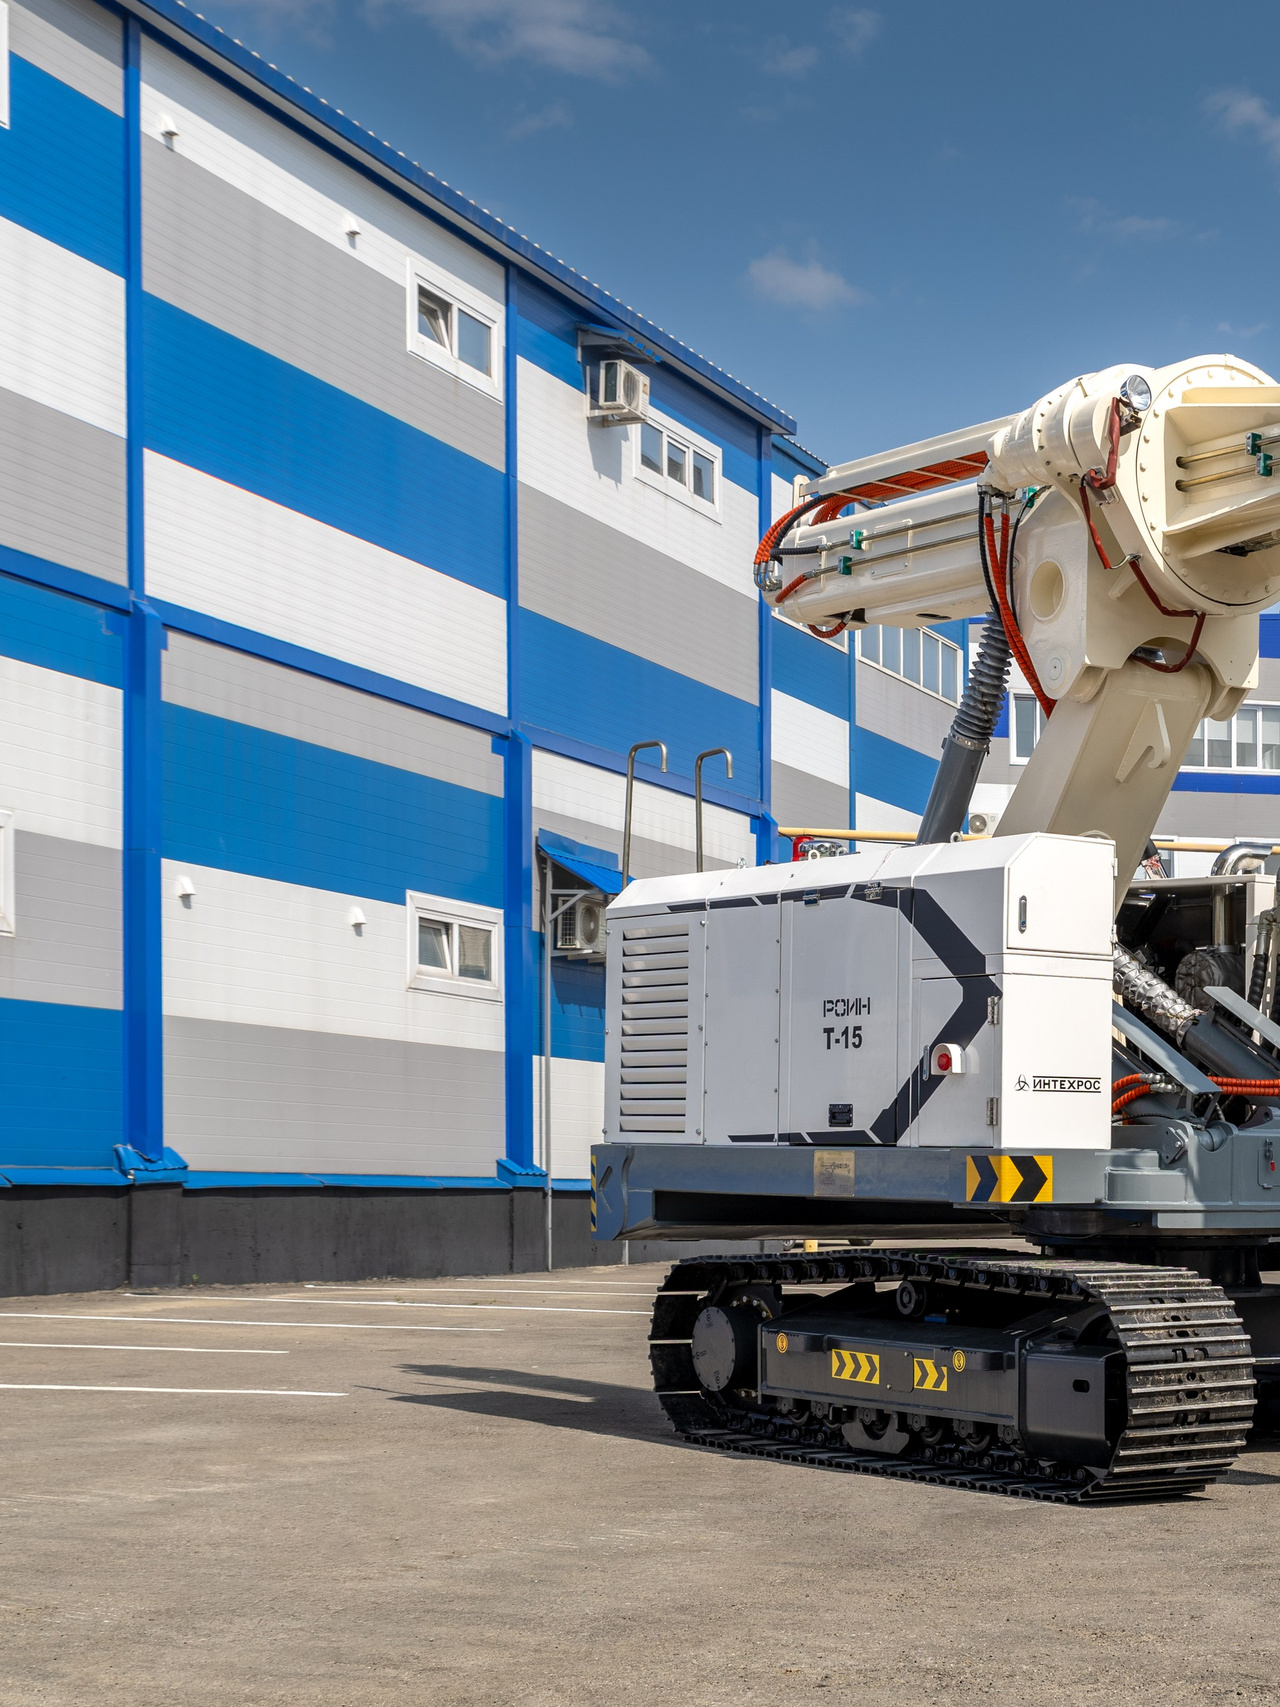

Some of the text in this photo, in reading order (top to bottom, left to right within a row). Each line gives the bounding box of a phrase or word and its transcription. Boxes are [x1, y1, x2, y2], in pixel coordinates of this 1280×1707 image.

[823, 996, 871, 1018] РОИН
[823, 1025, 863, 1050] Т-15
[1032, 1078, 1101, 1091] ИНТЕХРОС
